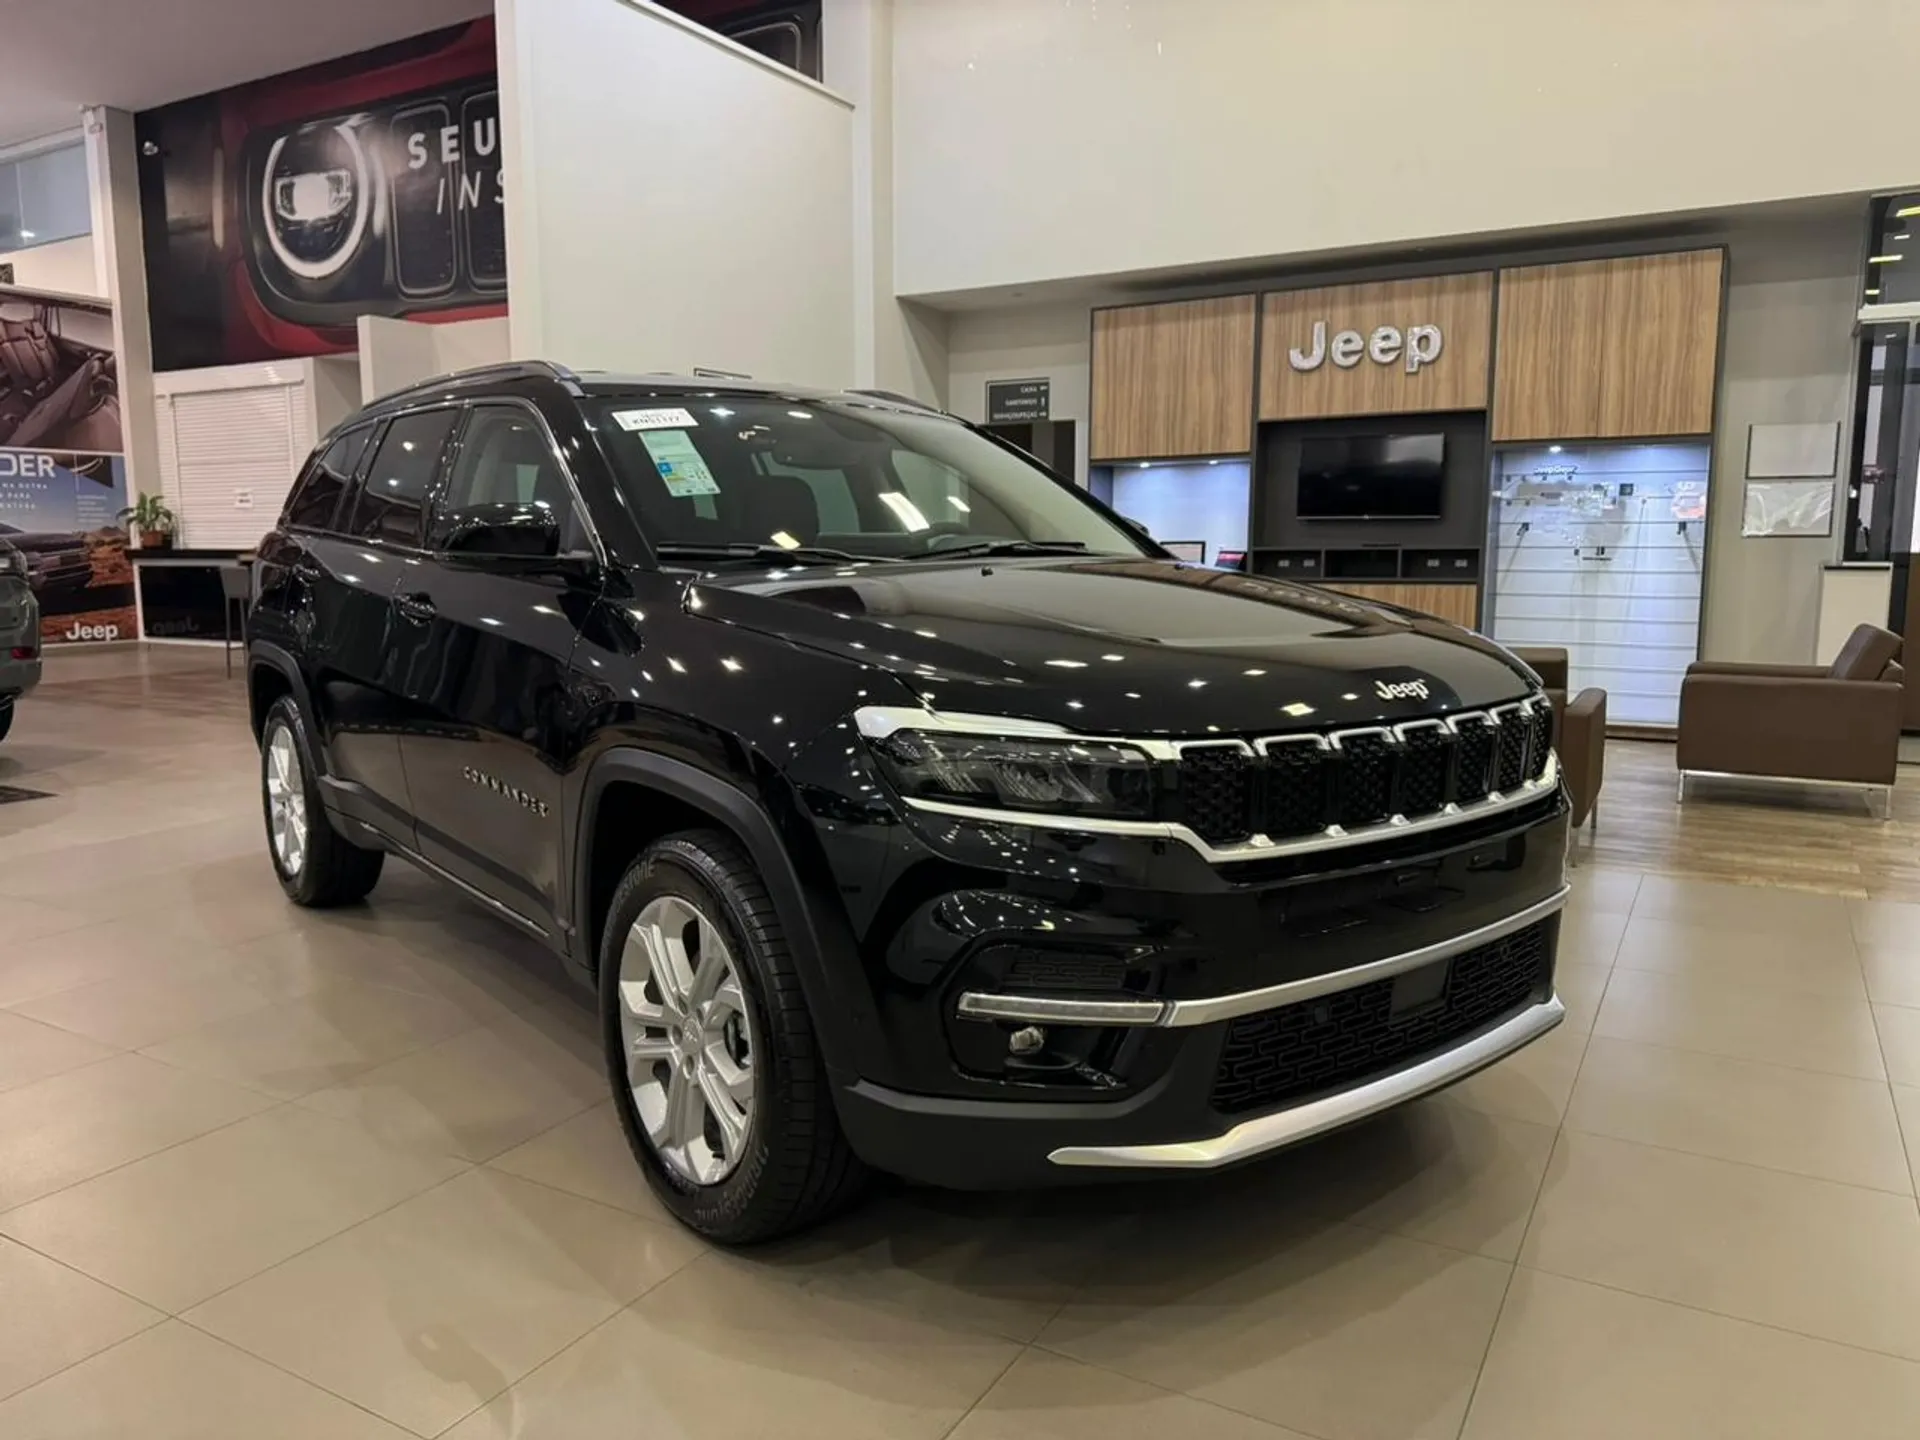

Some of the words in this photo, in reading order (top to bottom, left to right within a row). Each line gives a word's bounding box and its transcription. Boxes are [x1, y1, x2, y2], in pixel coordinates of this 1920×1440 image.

[407, 117, 496, 170] SEU
[1289, 320, 1443, 374] Jeep
[66, 621, 118, 641] Jeep
[1375, 678, 1430, 700] Jeep
